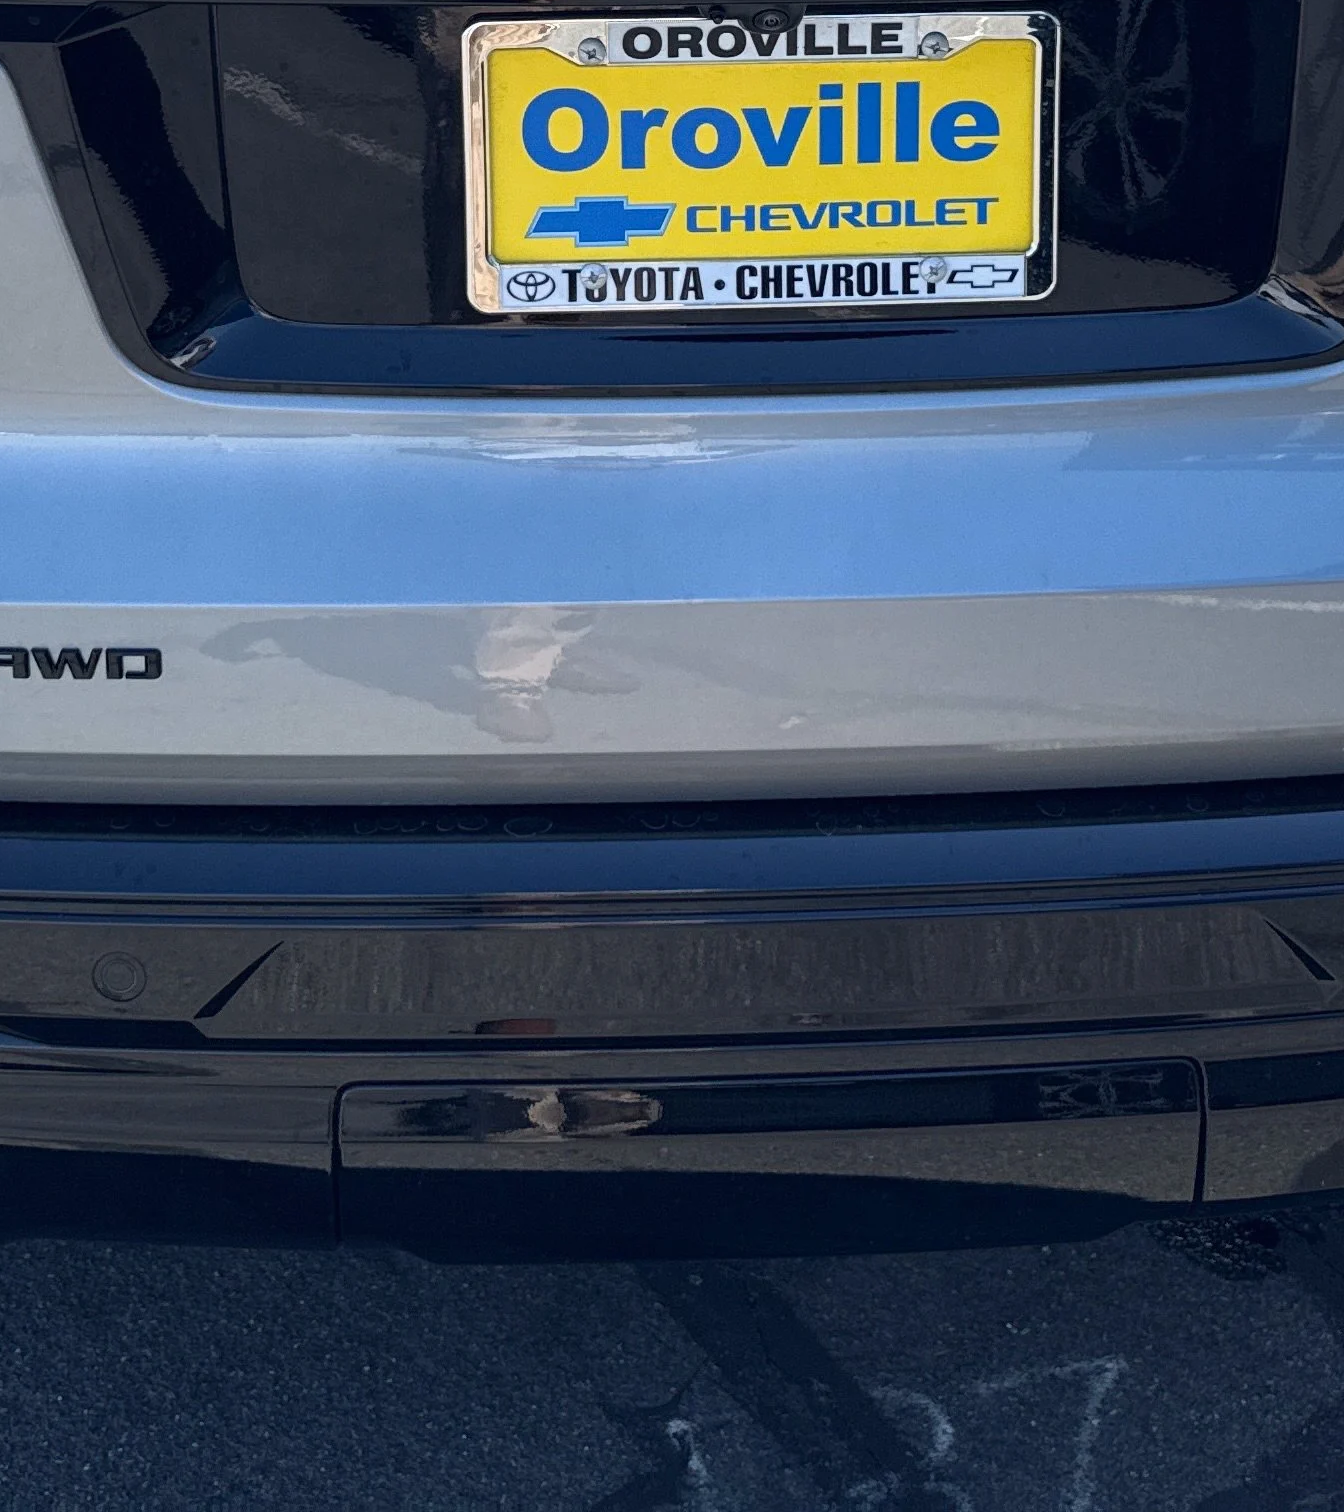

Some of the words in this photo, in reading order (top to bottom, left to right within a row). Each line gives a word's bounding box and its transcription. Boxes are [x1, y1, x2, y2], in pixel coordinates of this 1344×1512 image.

[622, 22, 903, 59] OROVILLE
[521, 81, 1000, 172] Oroville
[686, 197, 999, 232] CHEVROLET
